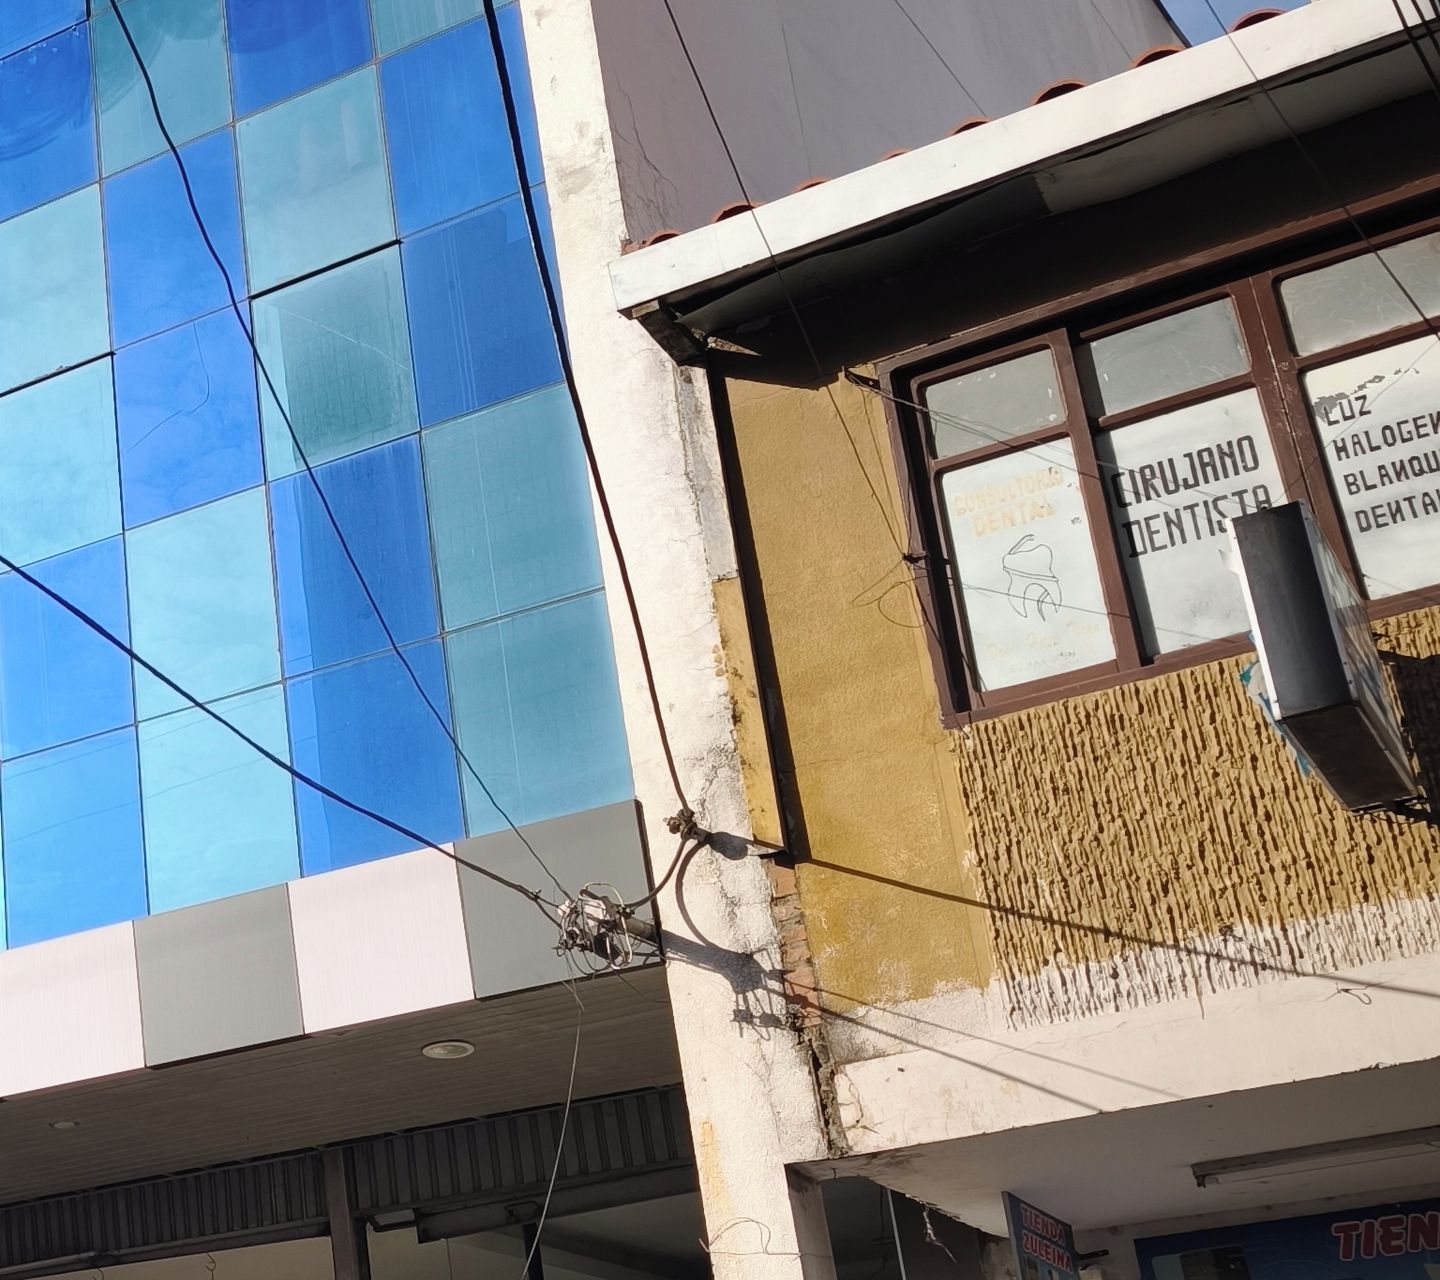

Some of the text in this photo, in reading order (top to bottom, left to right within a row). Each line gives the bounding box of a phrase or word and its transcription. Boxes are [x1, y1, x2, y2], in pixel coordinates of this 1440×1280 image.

[1323, 394, 1372, 426] LUZ
[1111, 435, 1259, 508] CIRUJANO
[1122, 484, 1273, 558] DENTISTA
[1355, 488, 1440, 533] DENTA
[1020, 1203, 1066, 1246] TIENDA
[1331, 1211, 1440, 1261] TIEN
